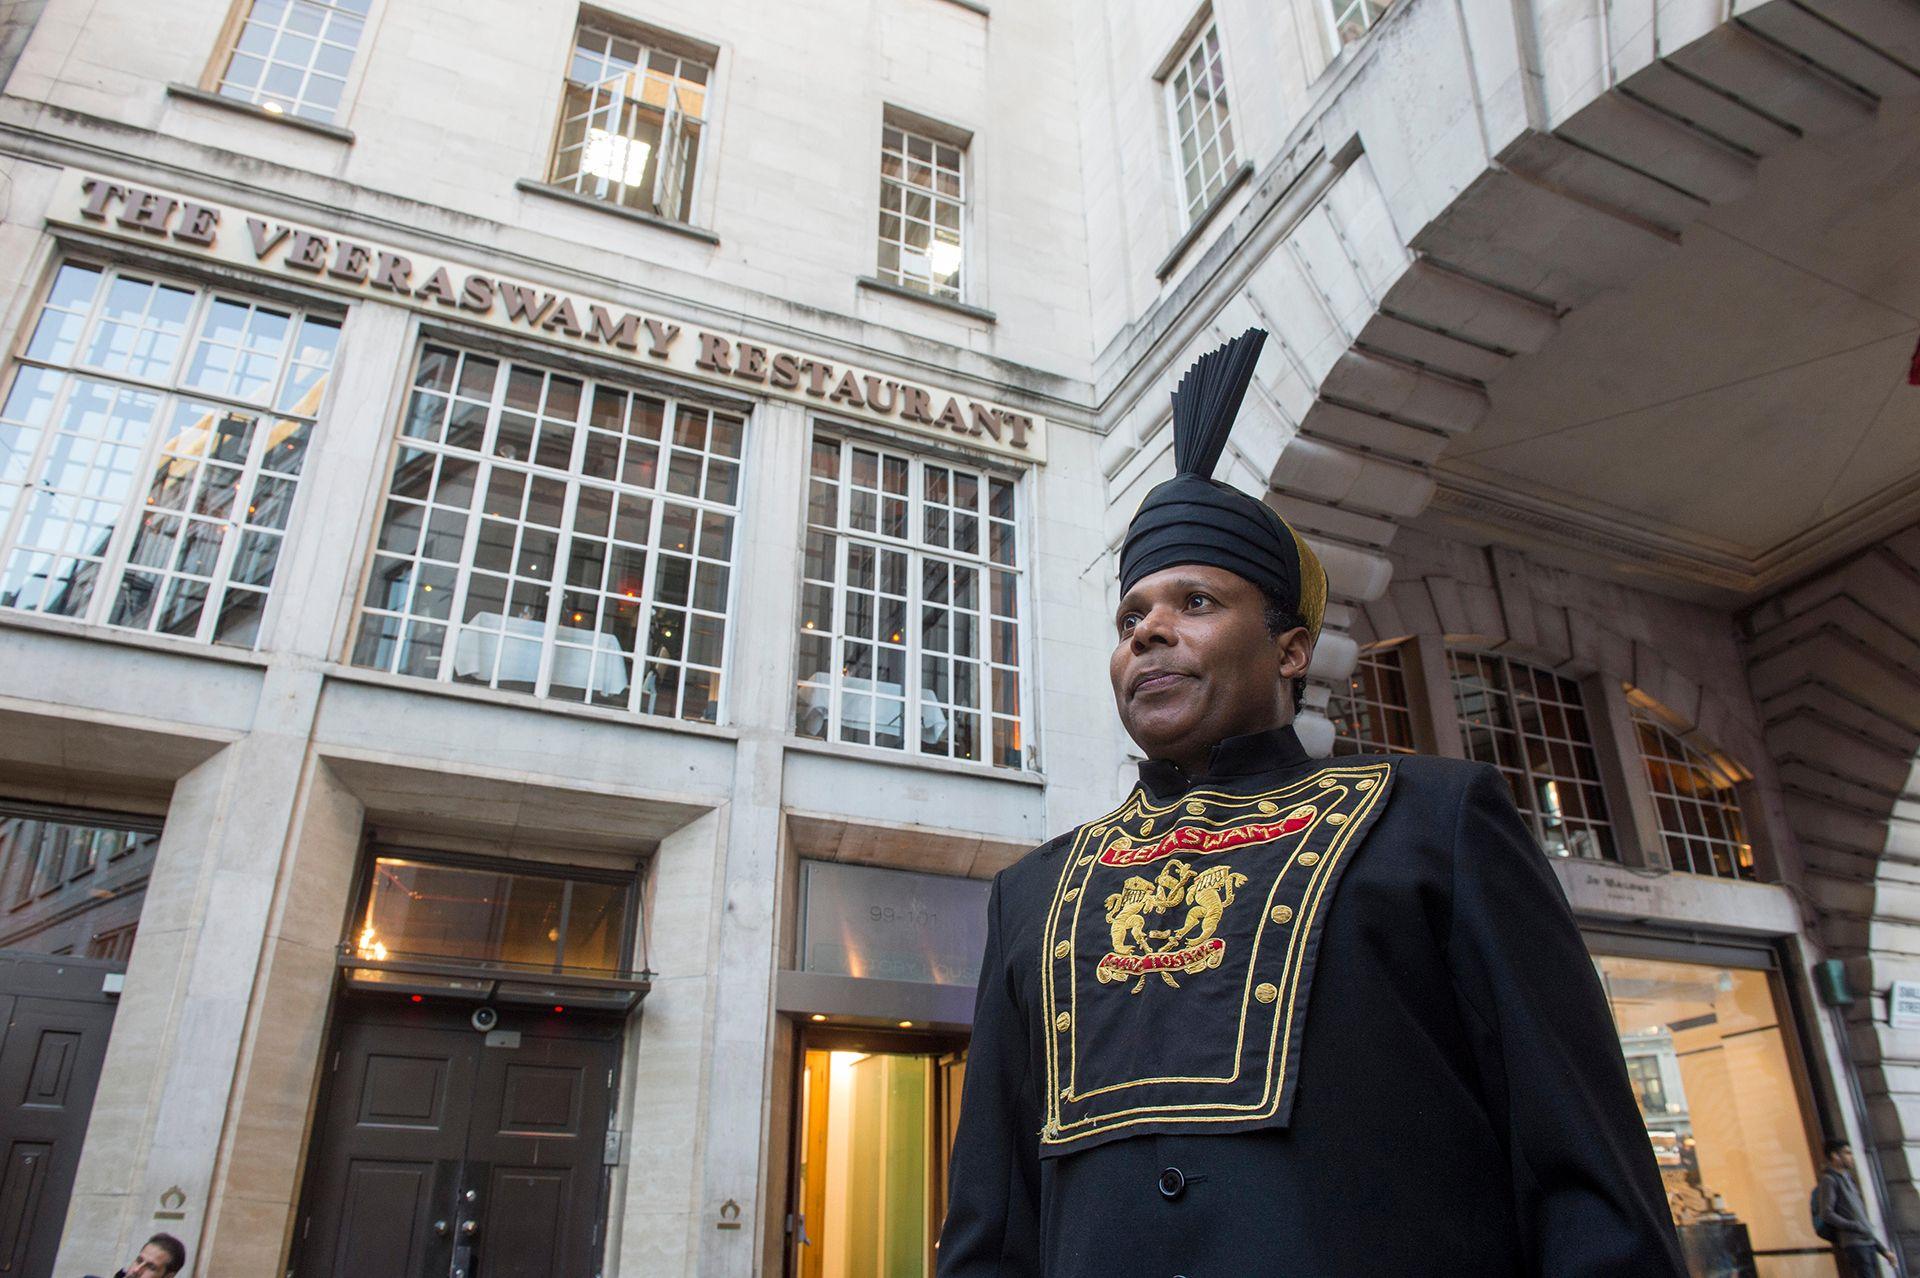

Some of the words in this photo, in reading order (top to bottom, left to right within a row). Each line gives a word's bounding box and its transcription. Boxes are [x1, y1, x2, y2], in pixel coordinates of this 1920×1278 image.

[79, 176, 221, 248] THE
[246, 216, 680, 359] VEERASWAMY
[696, 331, 1035, 450] RESTAURANT
[869, 905, 937, 927] 99-101
